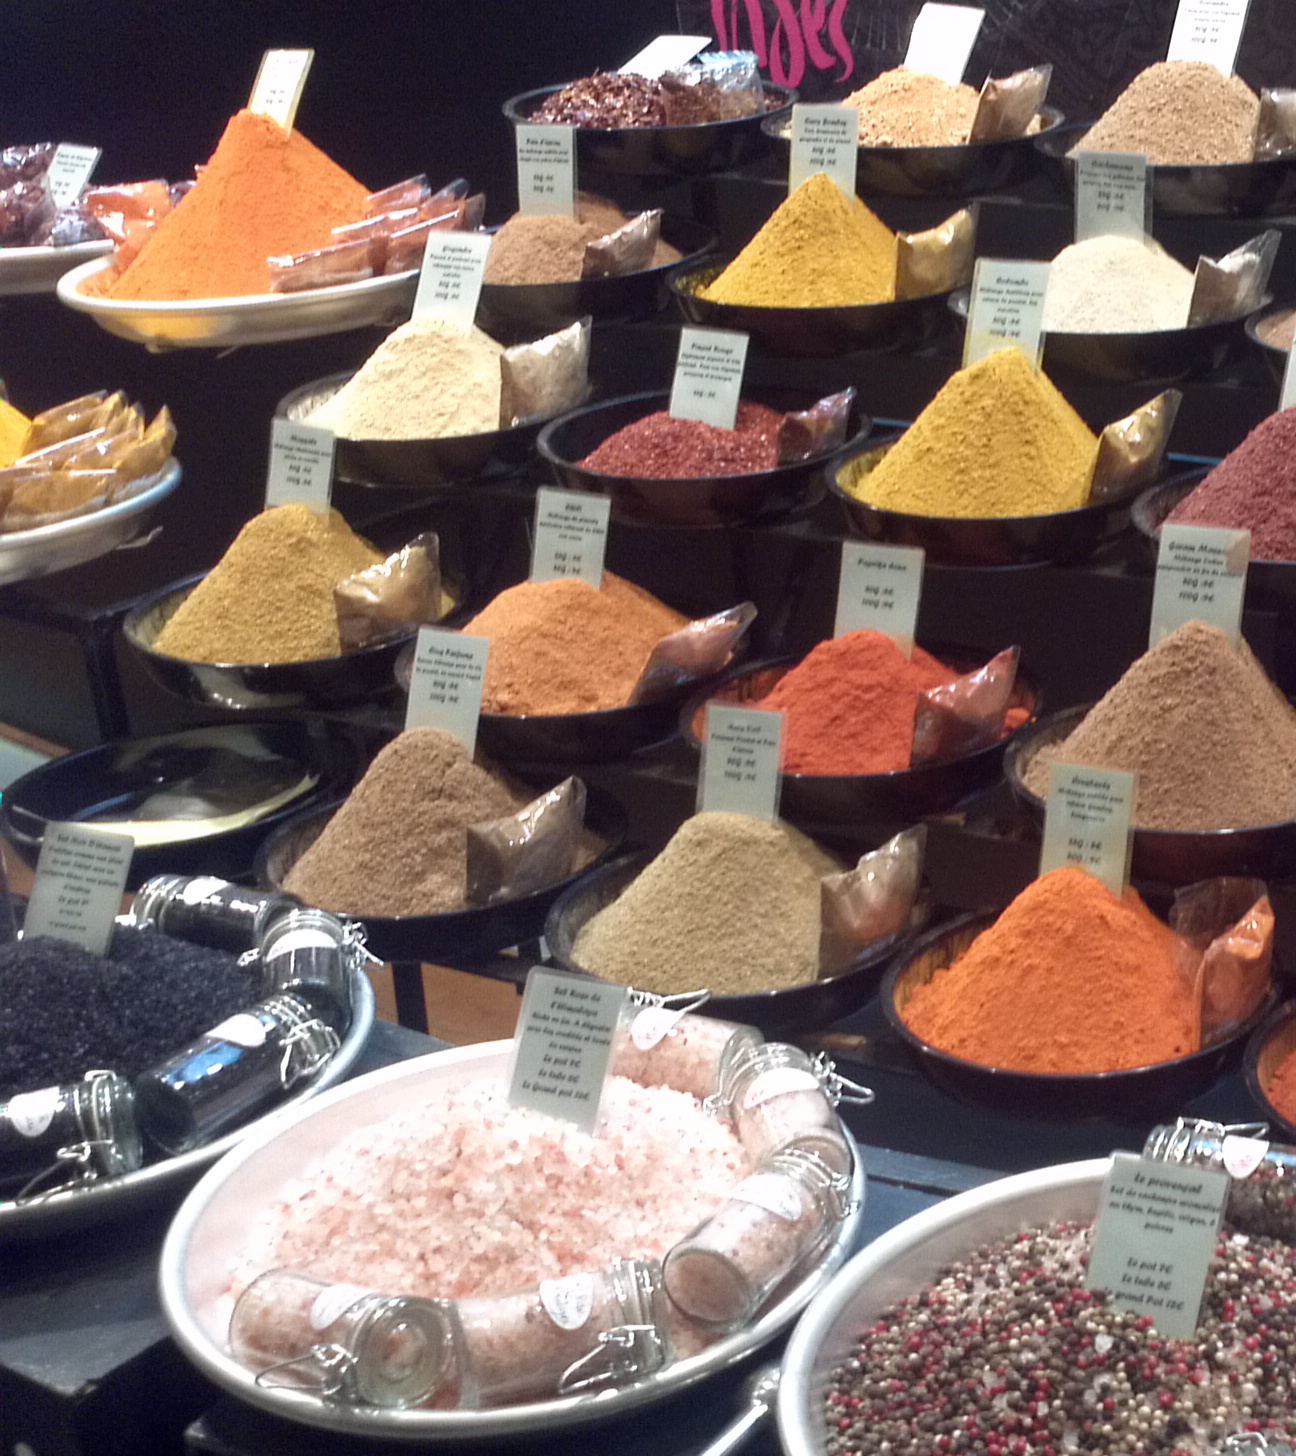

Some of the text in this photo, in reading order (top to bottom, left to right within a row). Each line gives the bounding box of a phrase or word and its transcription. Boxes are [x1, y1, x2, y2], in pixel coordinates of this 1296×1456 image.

[1134, 1172, 1204, 1195] Le provençal
[1139, 1260, 1158, 1273] pot
